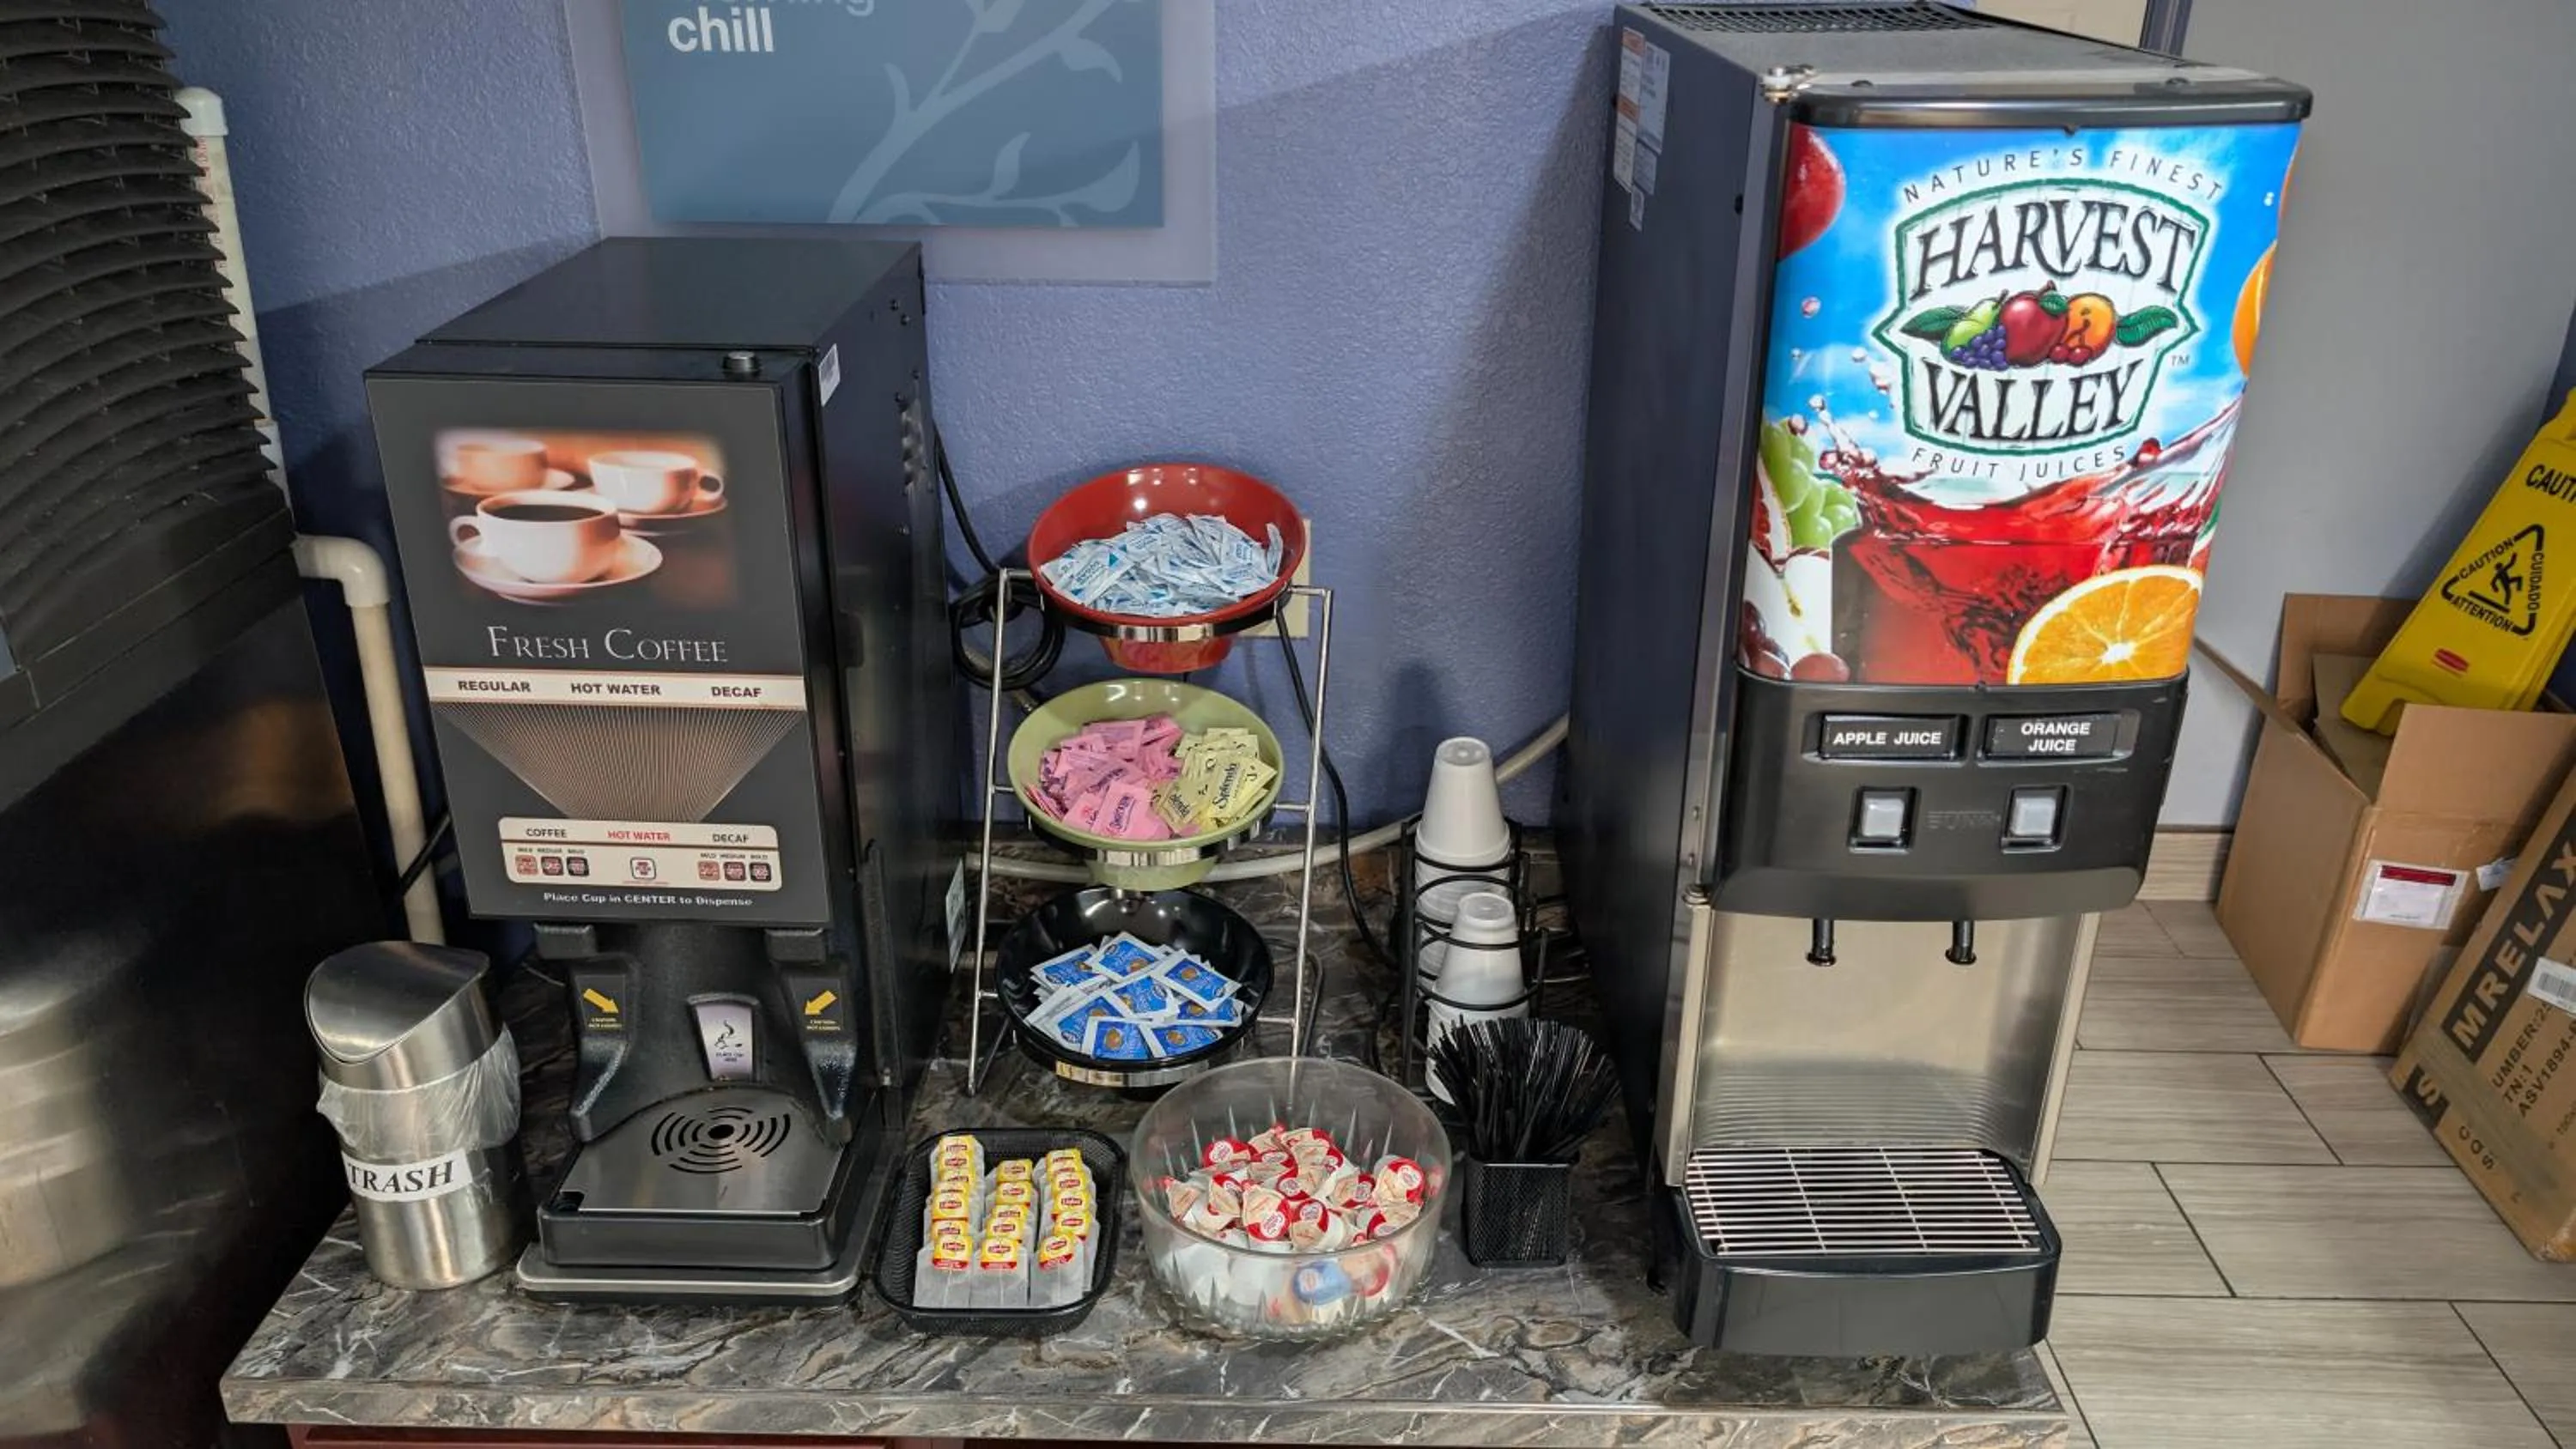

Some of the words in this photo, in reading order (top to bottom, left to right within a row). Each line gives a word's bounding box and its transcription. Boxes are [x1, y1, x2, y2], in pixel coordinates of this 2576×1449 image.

[668, 7, 774, 52] chill
[1903, 148, 2084, 203] NATURE'S
[2108, 150, 2223, 201] FINEST
[1911, 199, 2196, 300] HARVEST
[1923, 360, 2144, 442] VALLEY
[1911, 447, 2000, 479] FRUIT
[2020, 446, 2127, 480] JUICES
[2458, 537, 2515, 579] CAUTION
[2527, 552, 2543, 611] CUIDADO
[2450, 595, 2515, 632] ATTENTION
[487, 625, 590, 658] FRESH
[604, 627, 728, 663] COFFEE
[458, 680, 532, 693] REGULAR
[570, 682, 602, 694] HOT
[606, 683, 661, 696] WATER
[711, 686, 762, 700] DECAF
[1833, 731, 1887, 745] APPLE
[1893, 731, 1941, 746] JUICE
[2020, 722, 2091, 736] ORANGE
[2028, 738, 2076, 752] JUICE
[526, 828, 568, 839] COFFEE
[607, 830, 630, 840] HOT
[632, 831, 671, 841] WATER
[712, 833, 750, 844] DECAF
[544, 892, 578, 902] Place
[581, 894, 606, 904] Cup
[610, 894, 621, 902] in
[624, 894, 677, 905] CENTER
[678, 896, 692, 905] to
[696, 896, 753, 908] Dispense
[347, 1160, 454, 1193] TRASH
